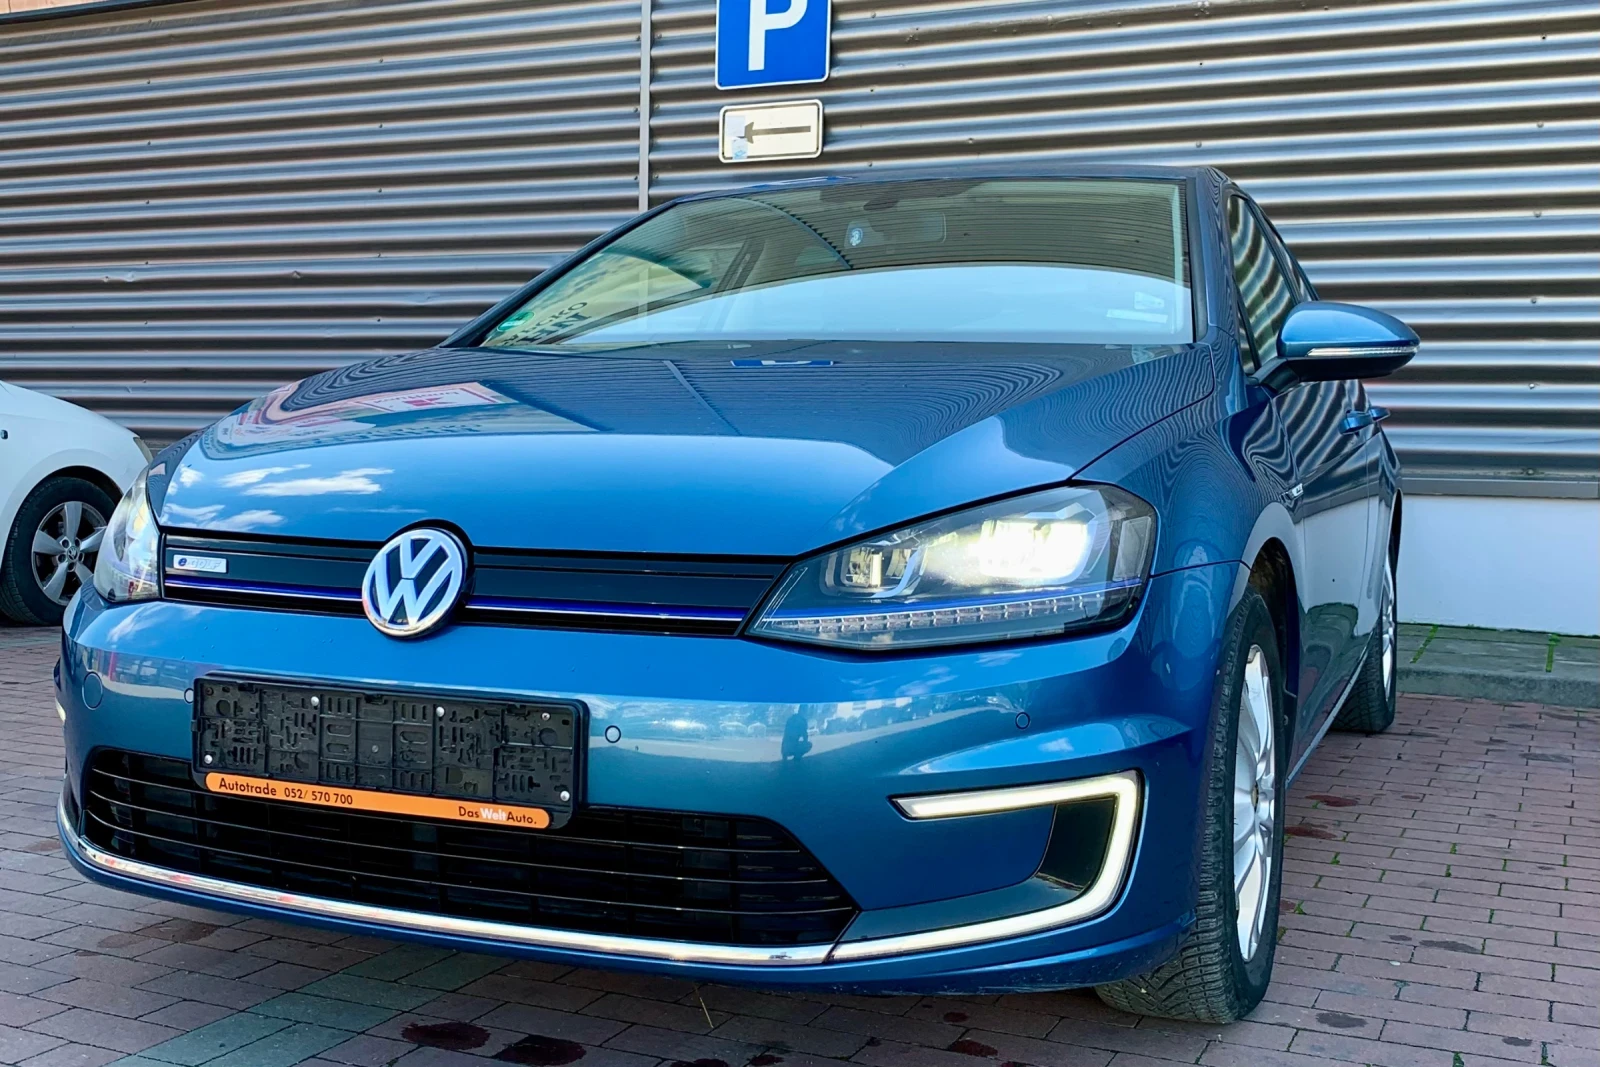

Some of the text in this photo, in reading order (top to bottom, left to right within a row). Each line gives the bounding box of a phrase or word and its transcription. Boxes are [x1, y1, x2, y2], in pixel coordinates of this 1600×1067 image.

[748, 0, 807, 71] P
[219, 778, 277, 796] Autotrade
[311, 790, 331, 802] 570
[333, 792, 353, 805] 700
